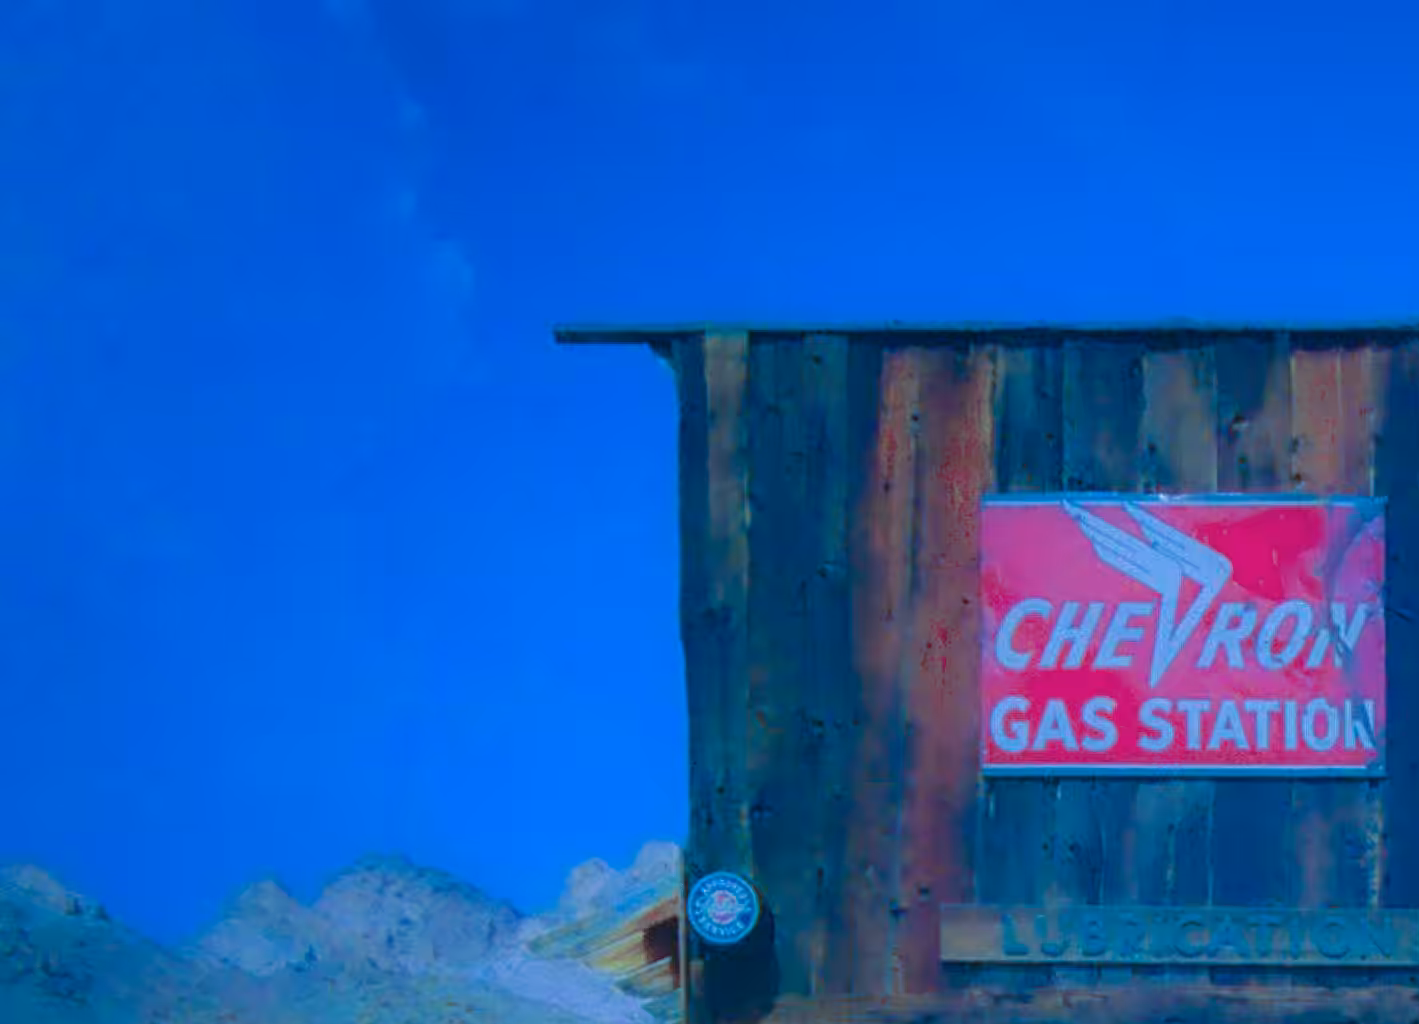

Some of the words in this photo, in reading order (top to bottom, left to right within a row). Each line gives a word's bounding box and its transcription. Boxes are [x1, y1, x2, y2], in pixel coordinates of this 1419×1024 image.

[995, 594, 1371, 688] CHEVRON
[989, 696, 1119, 752] GAS
[1138, 698, 1375, 751] STATION
